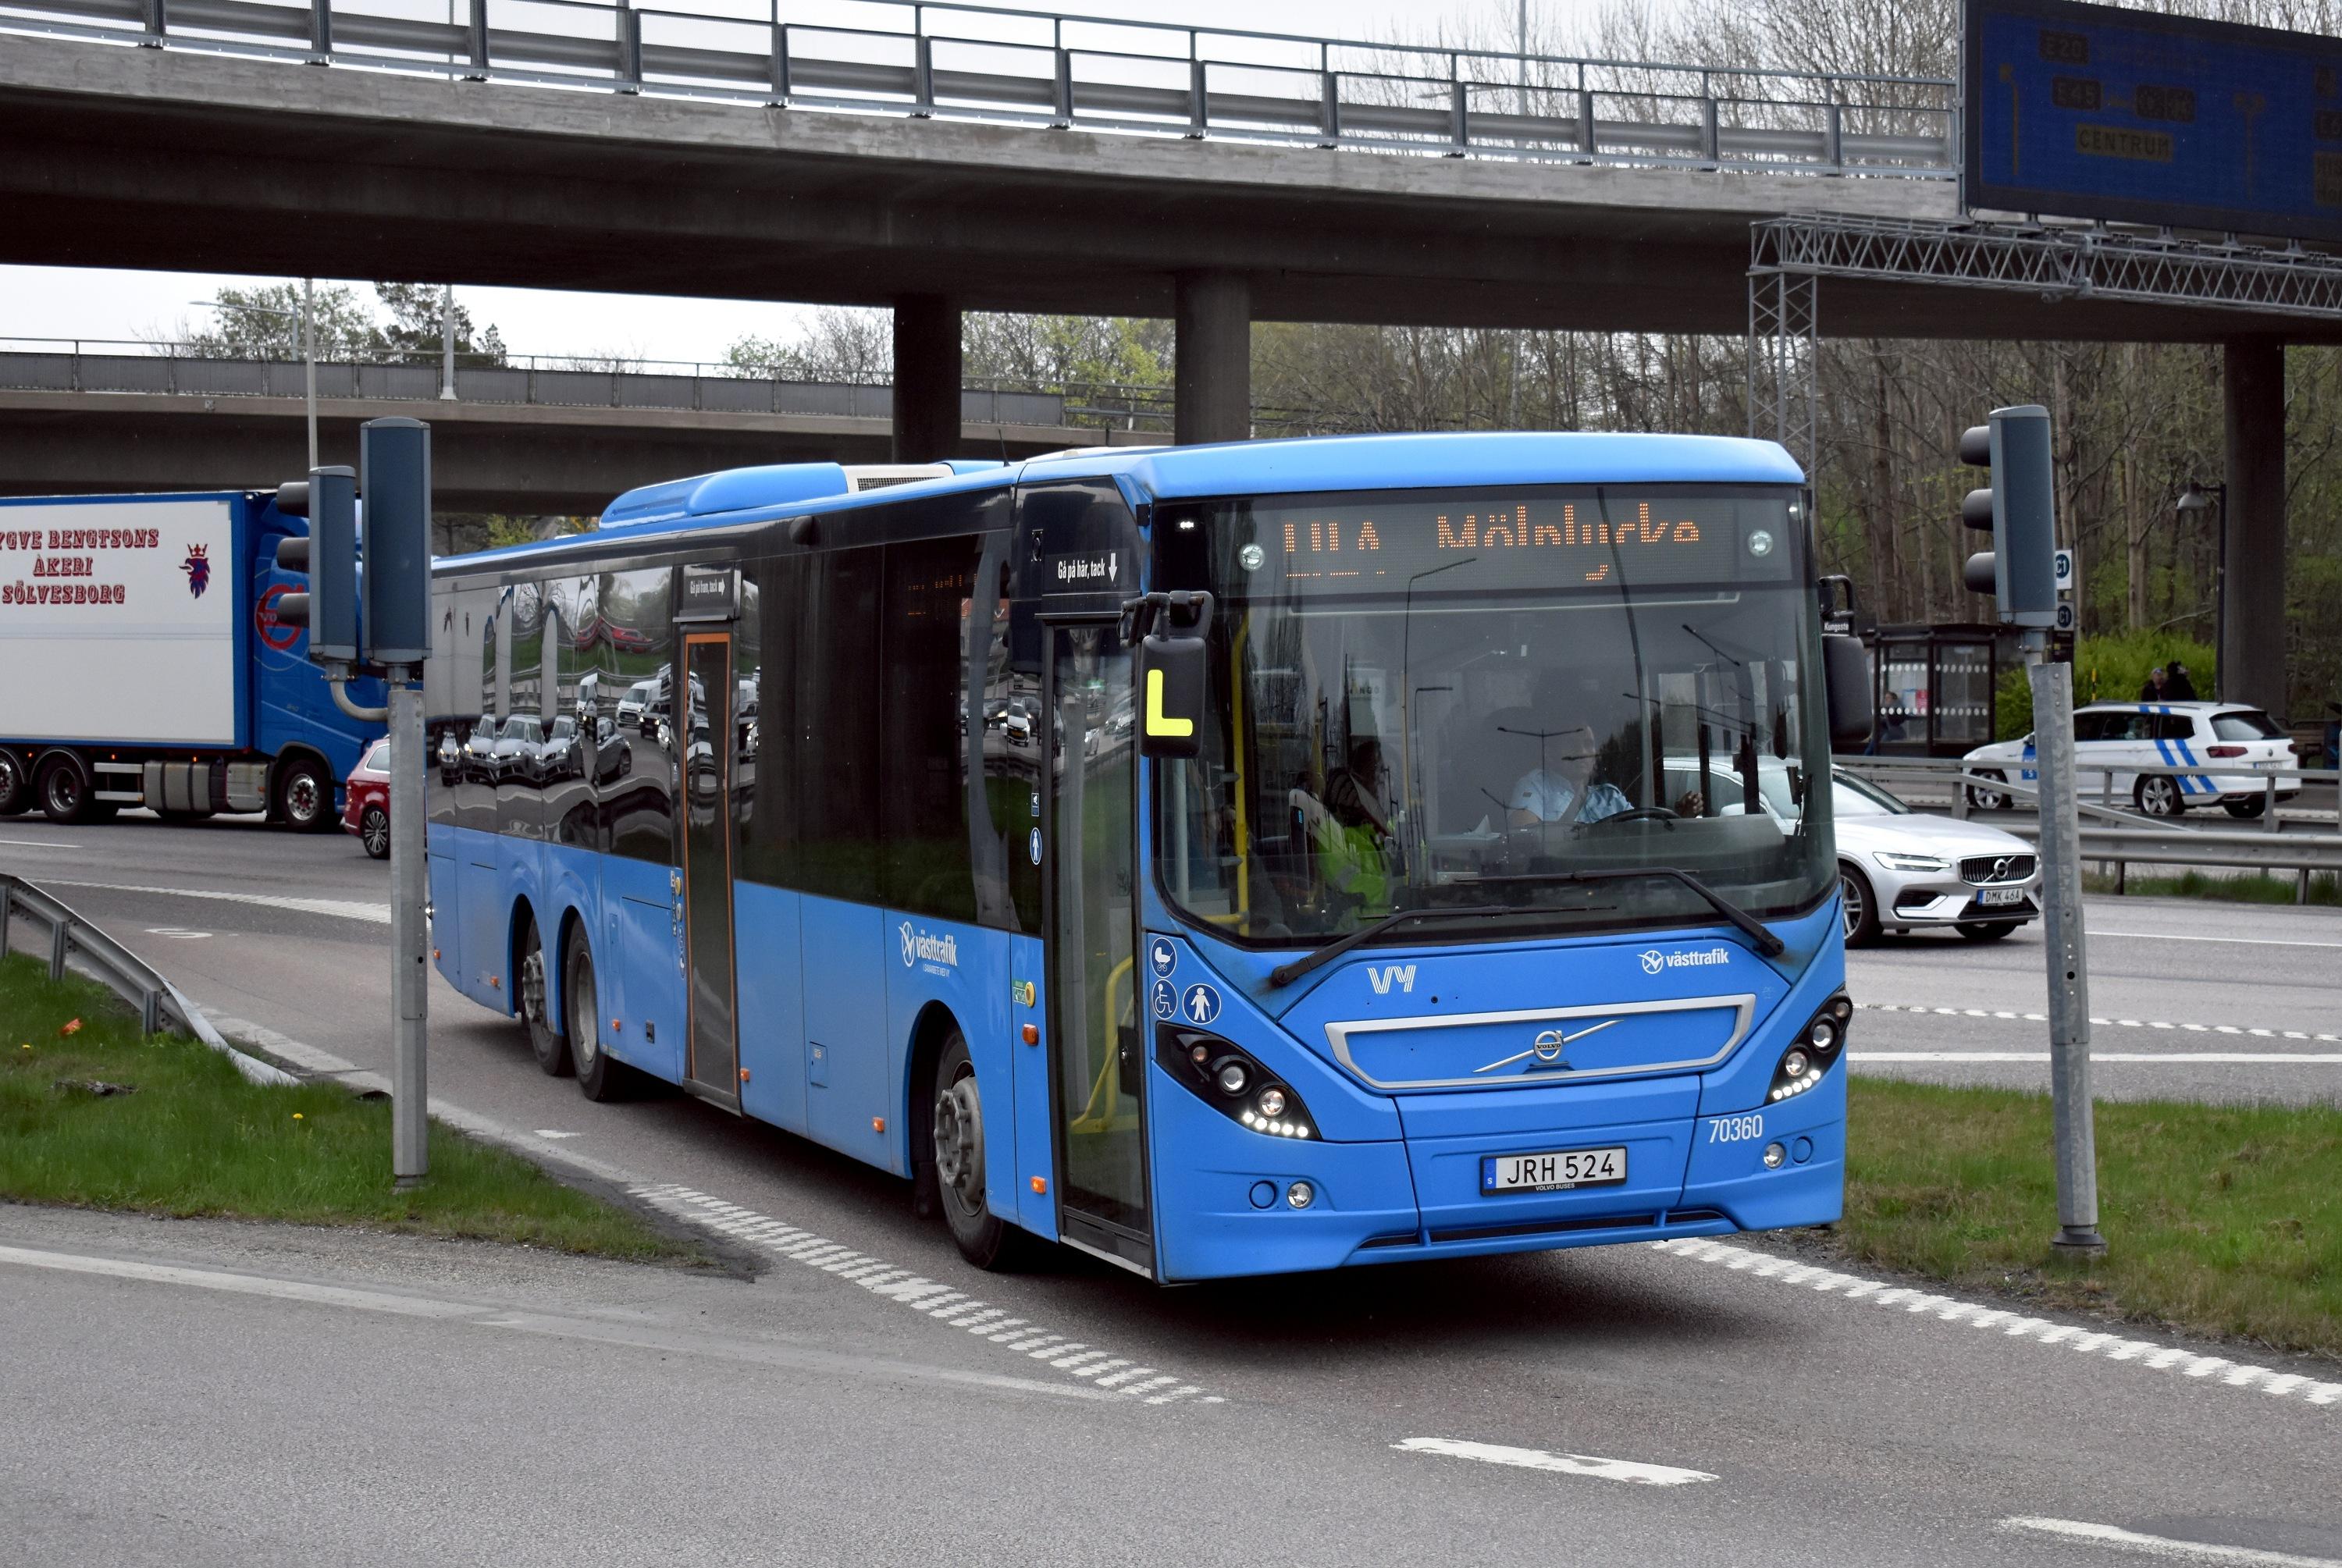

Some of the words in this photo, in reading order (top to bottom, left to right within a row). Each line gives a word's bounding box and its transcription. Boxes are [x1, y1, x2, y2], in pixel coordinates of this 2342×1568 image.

[2078, 129, 2170, 158] CENTRUM
[48, 528, 158, 549] BENGTSONS
[33, 553, 93, 576] ÅKERI
[1058, 560, 1066, 579] Gå
[1067, 559, 1076, 584] på
[1077, 559, 1090, 580] här,
[1091, 557, 1105, 577] tack
[2, 580, 125, 604] SÖLVESBORG
[1824, 622, 1849, 632] Kungsste
[916, 929, 958, 966] västtrafik
[1665, 948, 1729, 968] västtrafik
[1708, 1114, 1763, 1143] 70360
[1507, 1157, 1555, 1185] JRH
[1565, 1153, 1614, 1179] 524
